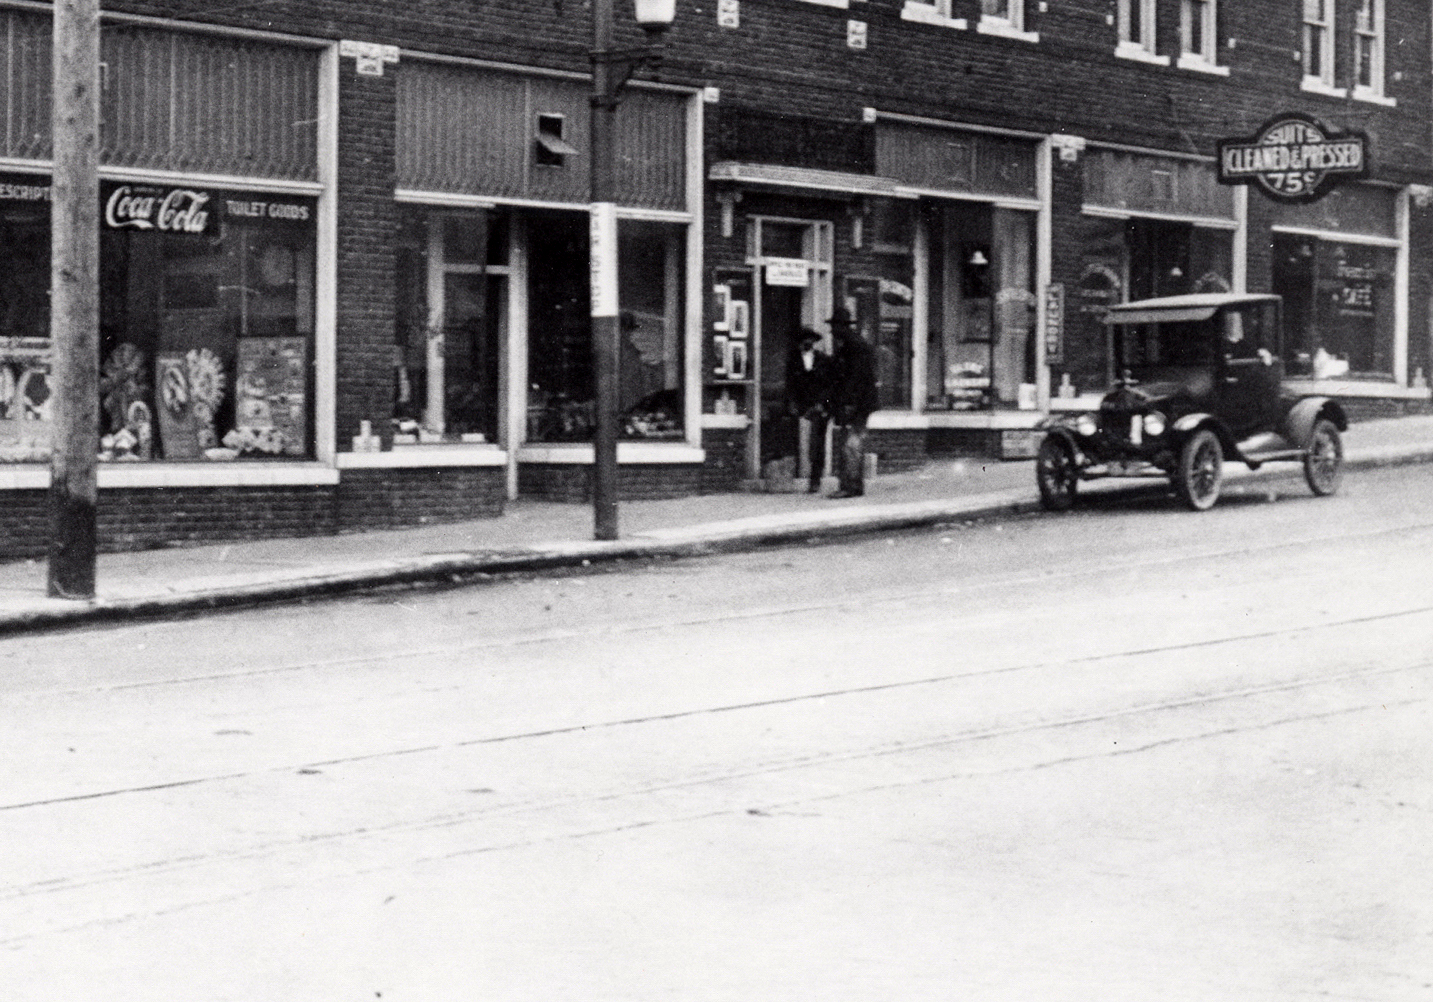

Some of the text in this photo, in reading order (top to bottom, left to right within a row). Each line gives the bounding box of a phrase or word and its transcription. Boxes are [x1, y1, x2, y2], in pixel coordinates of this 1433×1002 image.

[1262, 123, 1323, 145] SUITS
[1227, 145, 1290, 172] CLEANED
[1301, 143, 1361, 169] PRESSED
[105, 185, 210, 233] Coca-Cola
[226, 200, 310, 220] TOILET GOODS
